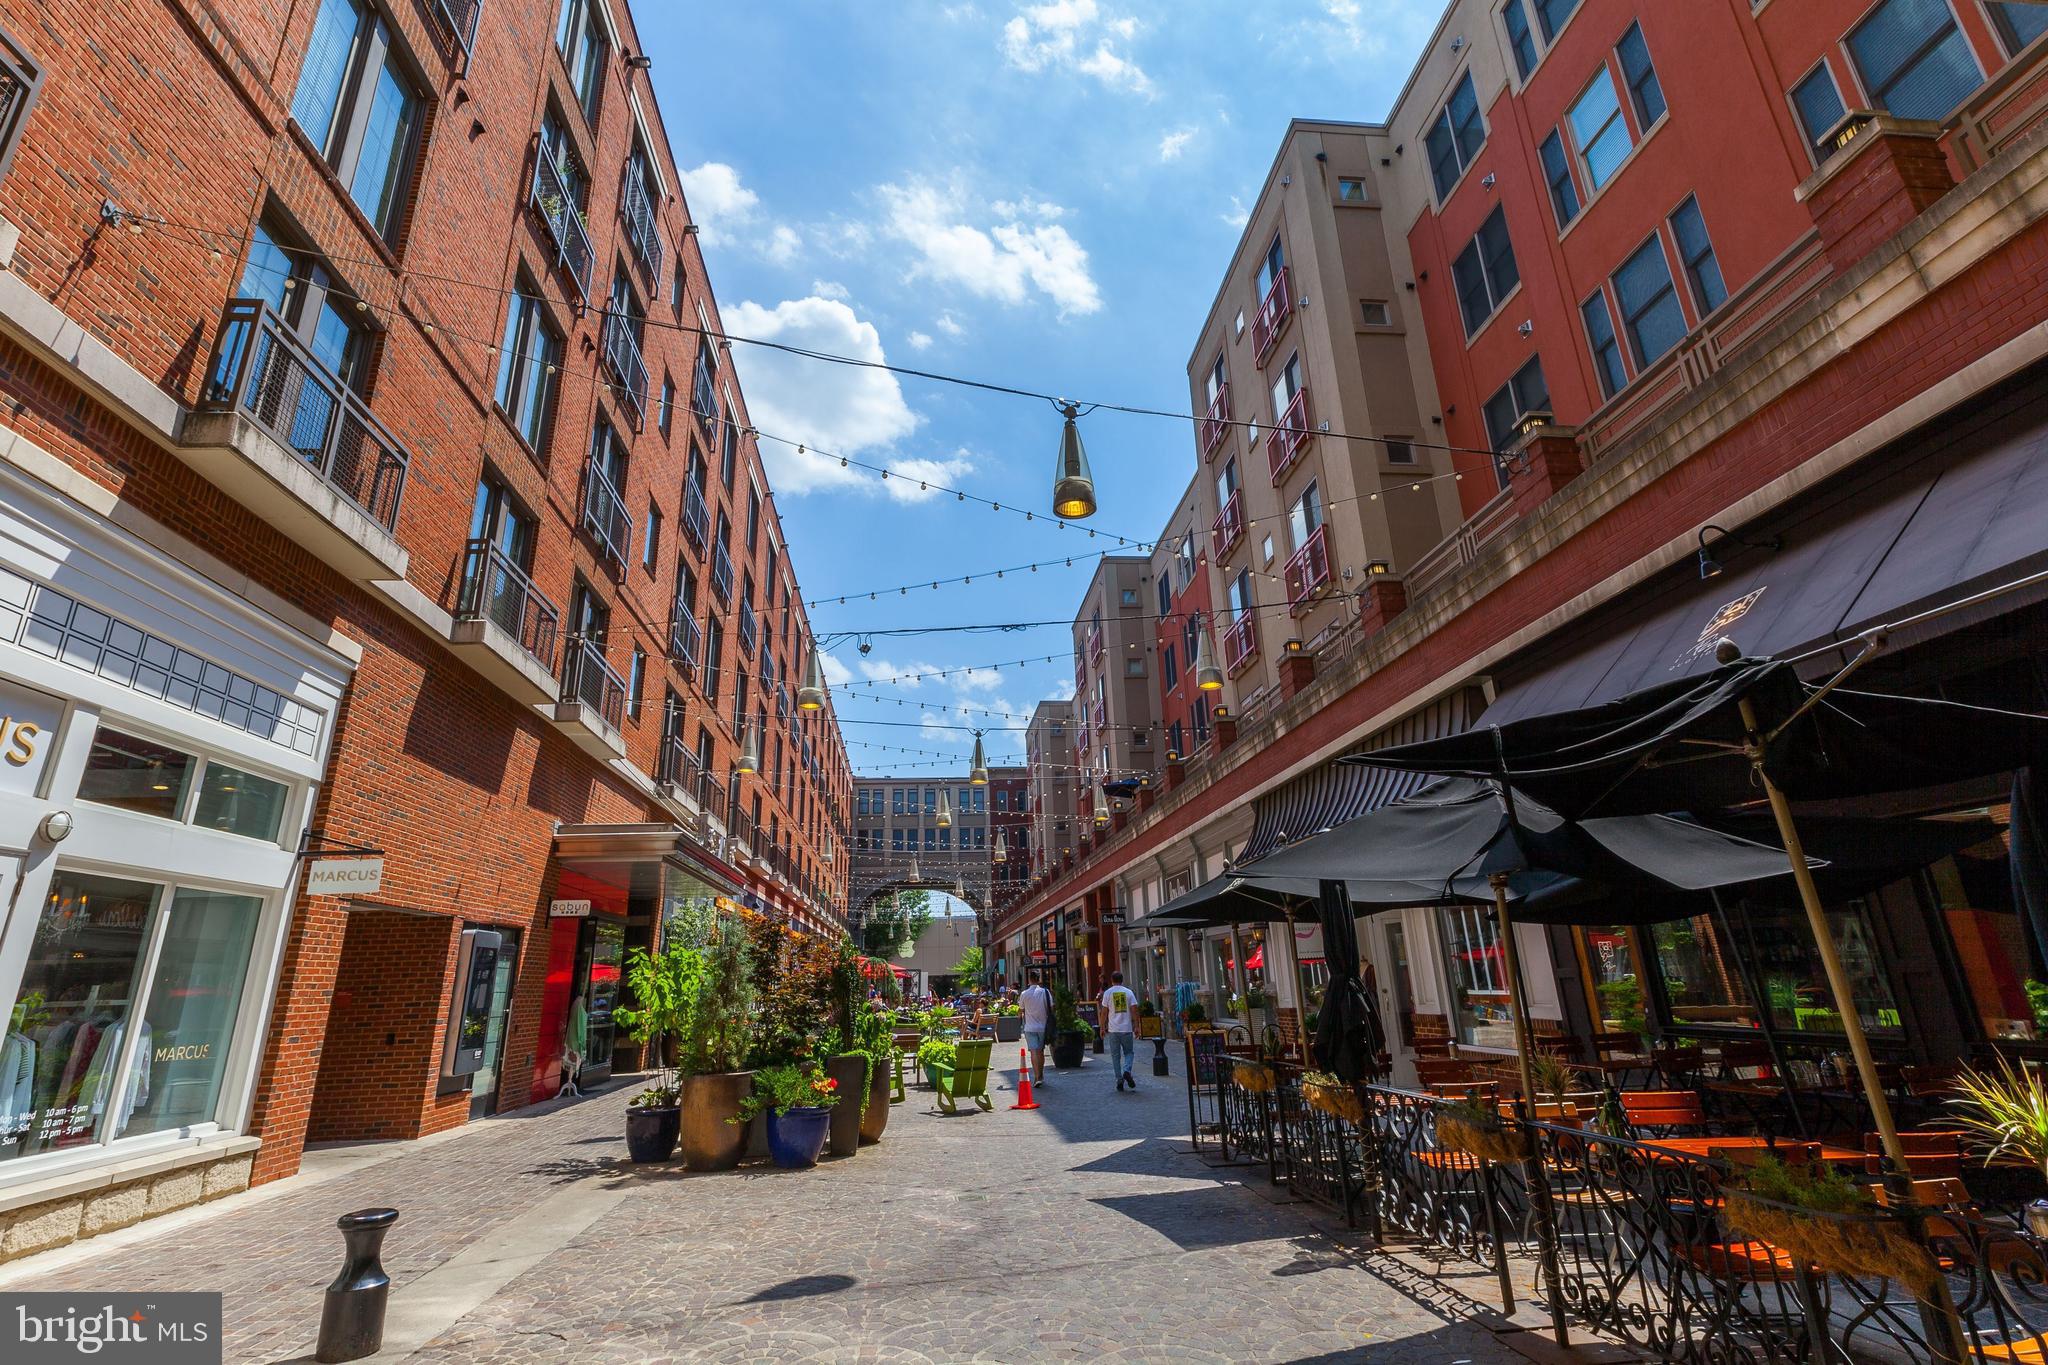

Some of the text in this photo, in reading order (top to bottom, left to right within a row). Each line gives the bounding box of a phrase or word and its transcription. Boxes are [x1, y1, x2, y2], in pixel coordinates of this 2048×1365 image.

[312, 869, 378, 882] MARCUS
[552, 901, 589, 911] sabun
[155, 1044, 209, 1062] MARCUS
[19, 1111, 37, 1120] Wed
[45, 1108, 55, 1117] 10
[71, 1105, 77, 1113] 6
[76, 1105, 88, 1114] pm
[18, 1123, 31, 1132] Sat
[42, 1120, 52, 1128] 10
[69, 1115, 74, 1123] 7
[74, 1116, 85, 1124] pm
[1, 1137, 17, 1145] Sun
[39, 1130, 48, 1139] 12
[49, 1130, 61, 1139] pm
[71, 1127, 83, 1135] pm
